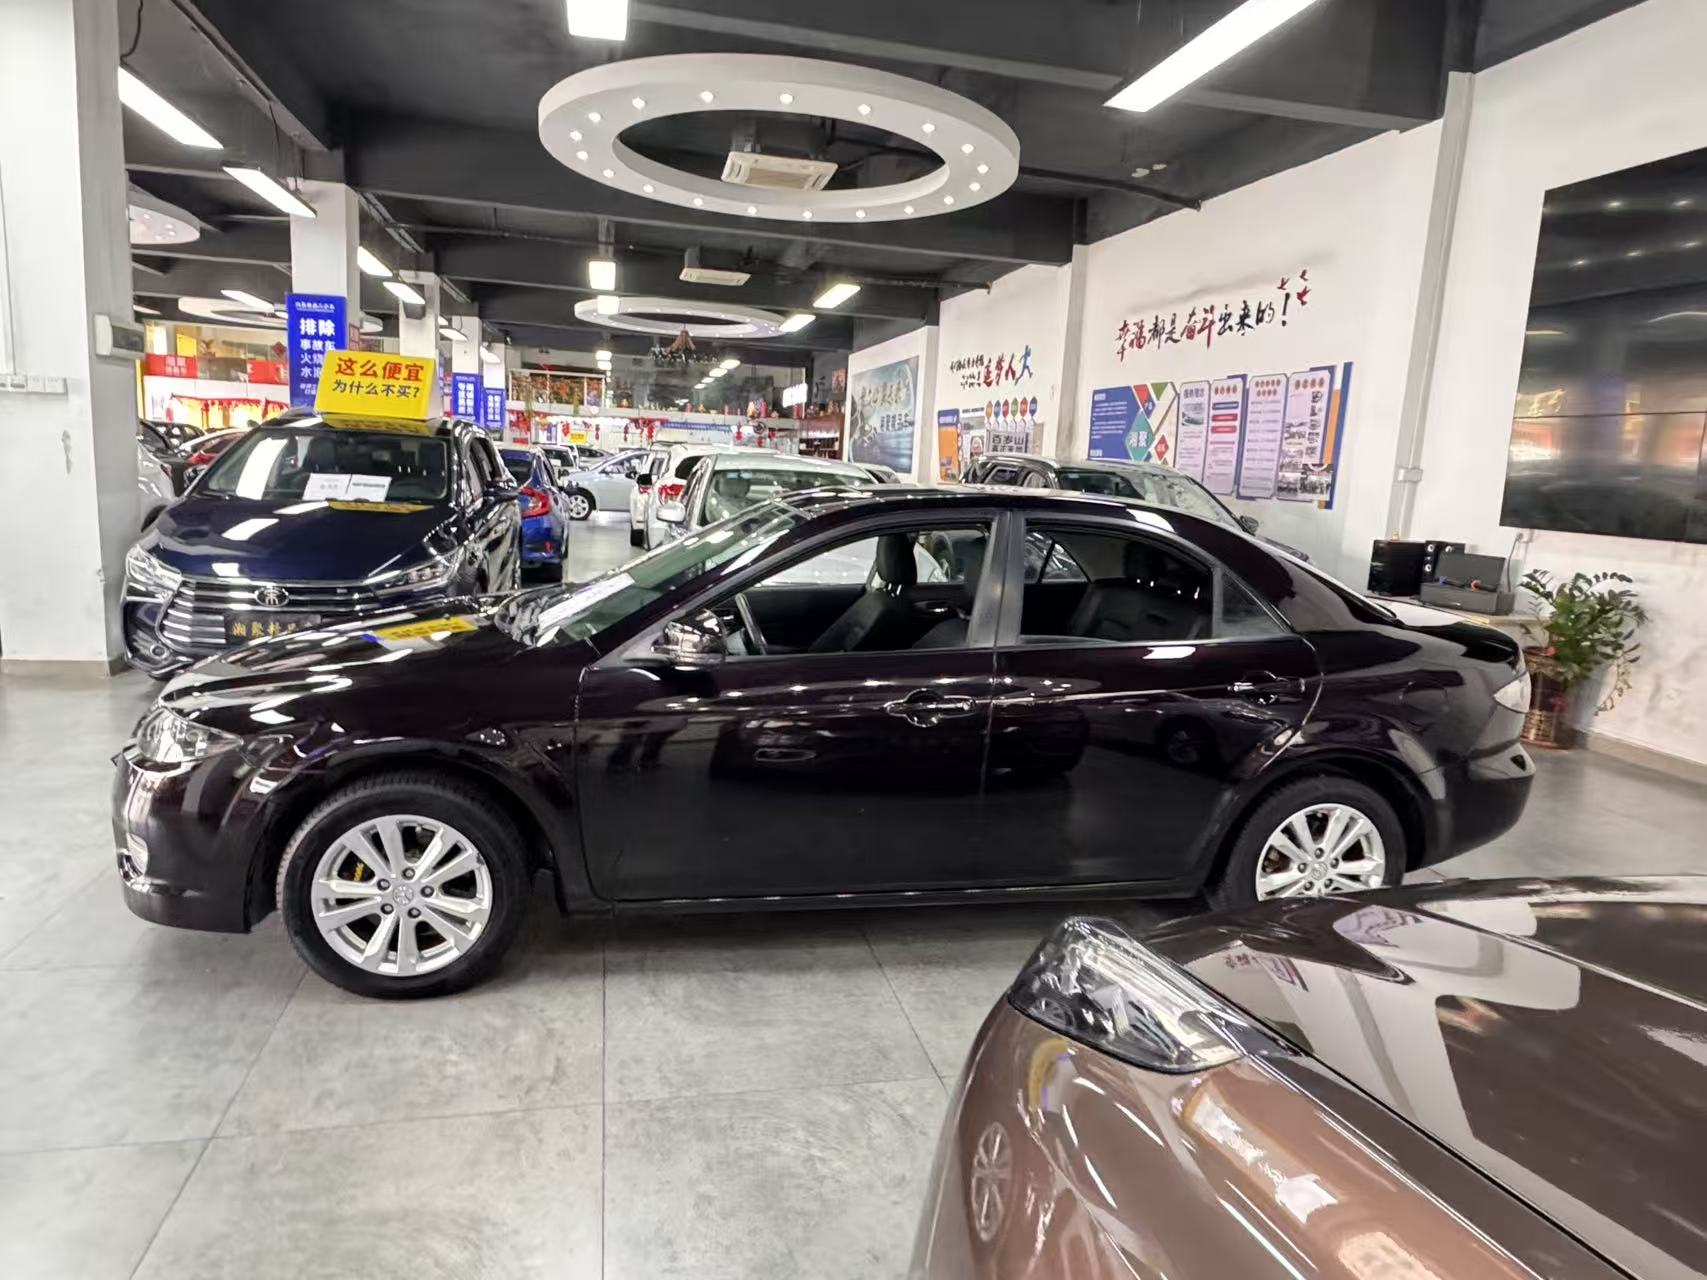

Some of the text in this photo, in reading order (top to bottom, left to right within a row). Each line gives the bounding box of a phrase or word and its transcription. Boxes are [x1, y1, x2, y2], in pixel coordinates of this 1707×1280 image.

[300, 318, 335, 337] 排除
[1114, 292, 1291, 362] 幸福都是奋斗出来的!
[300, 339, 335, 351] 事故车
[335, 357, 424, 382] 这么便宜
[983, 353, 1016, 387] 追梦人
[332, 379, 420, 398] 为什么不买?
[992, 434, 1024, 444] 百岁山
